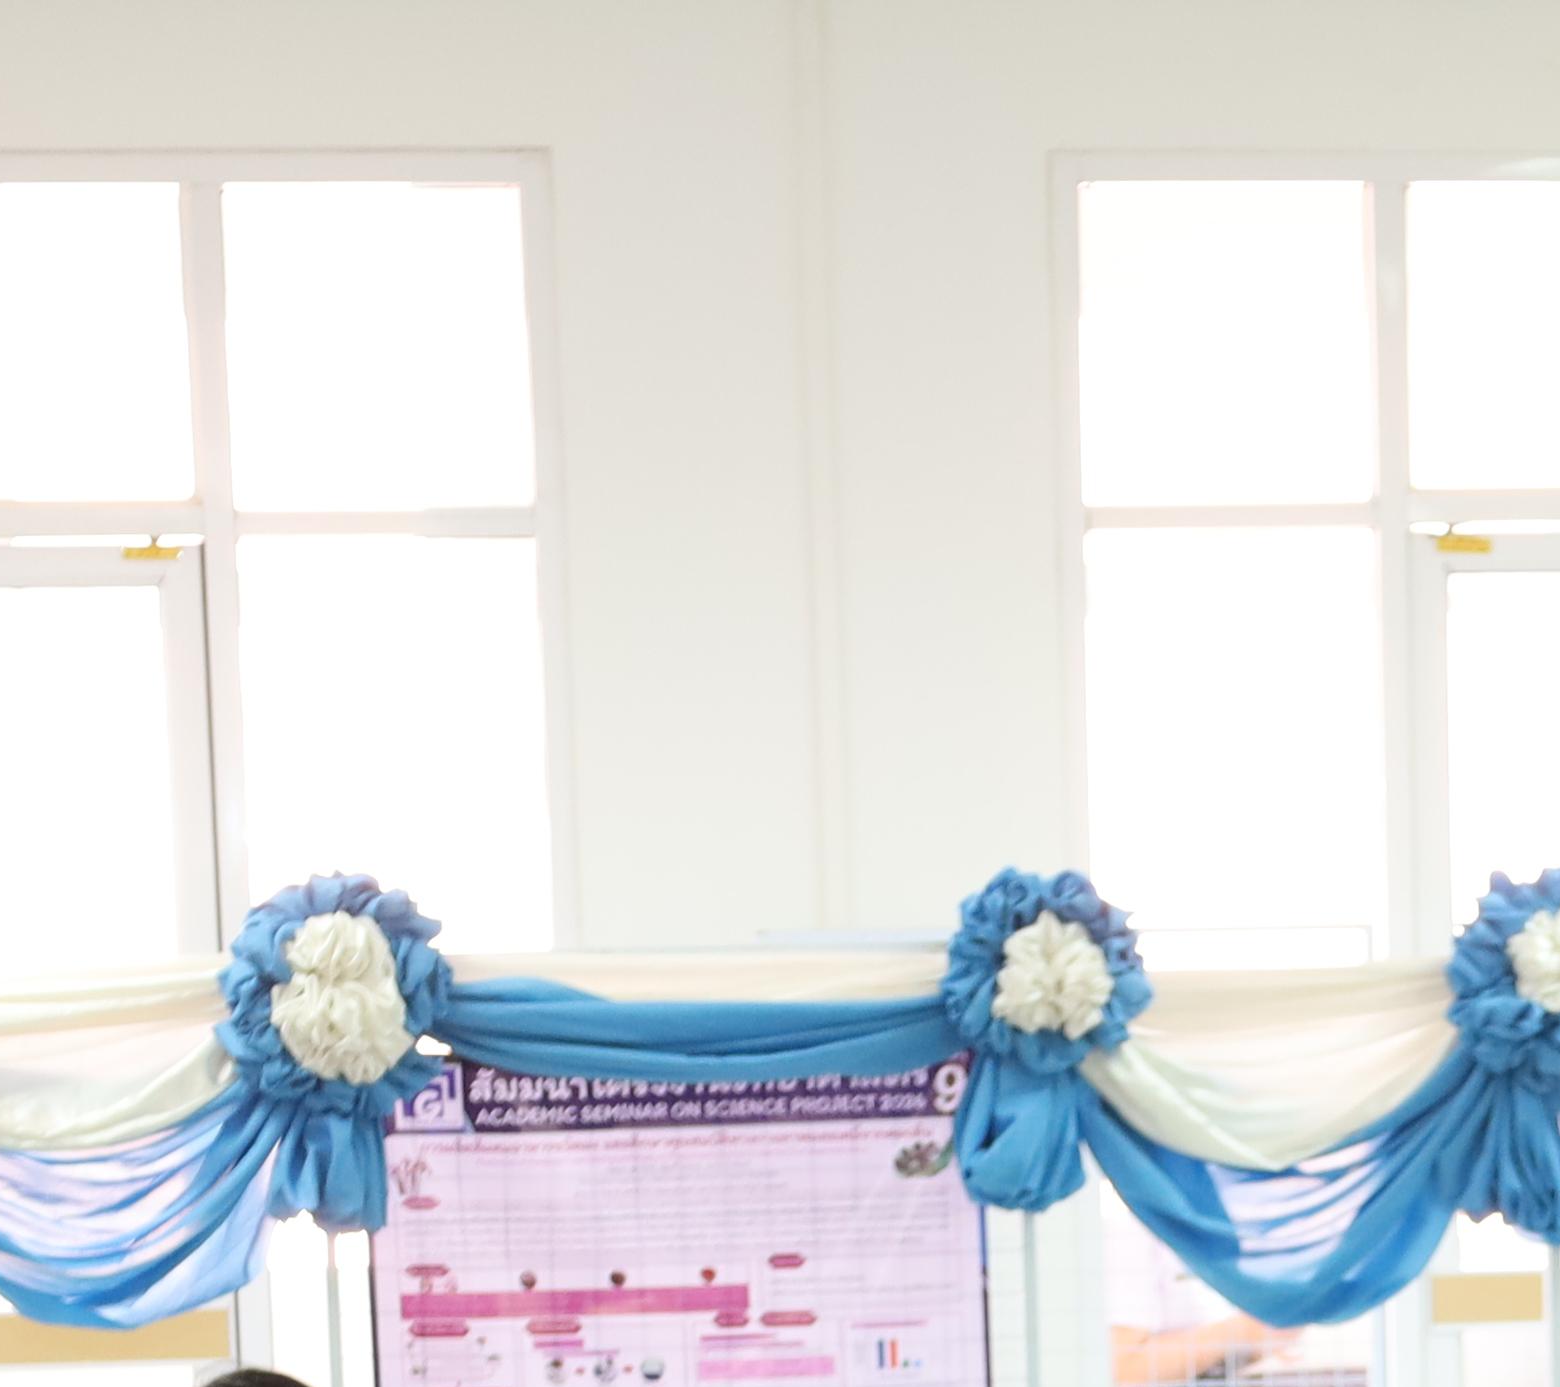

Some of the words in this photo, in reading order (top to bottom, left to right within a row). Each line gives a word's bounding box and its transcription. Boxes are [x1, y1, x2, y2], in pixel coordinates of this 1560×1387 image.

[475, 1104, 578, 1126] ACADEMIC
[580, 1101, 668, 1122] SEMINAR
[669, 1099, 702, 1120] ON
[703, 1096, 786, 1118] SCIENCE
[790, 1093, 876, 1115] PROJECT
